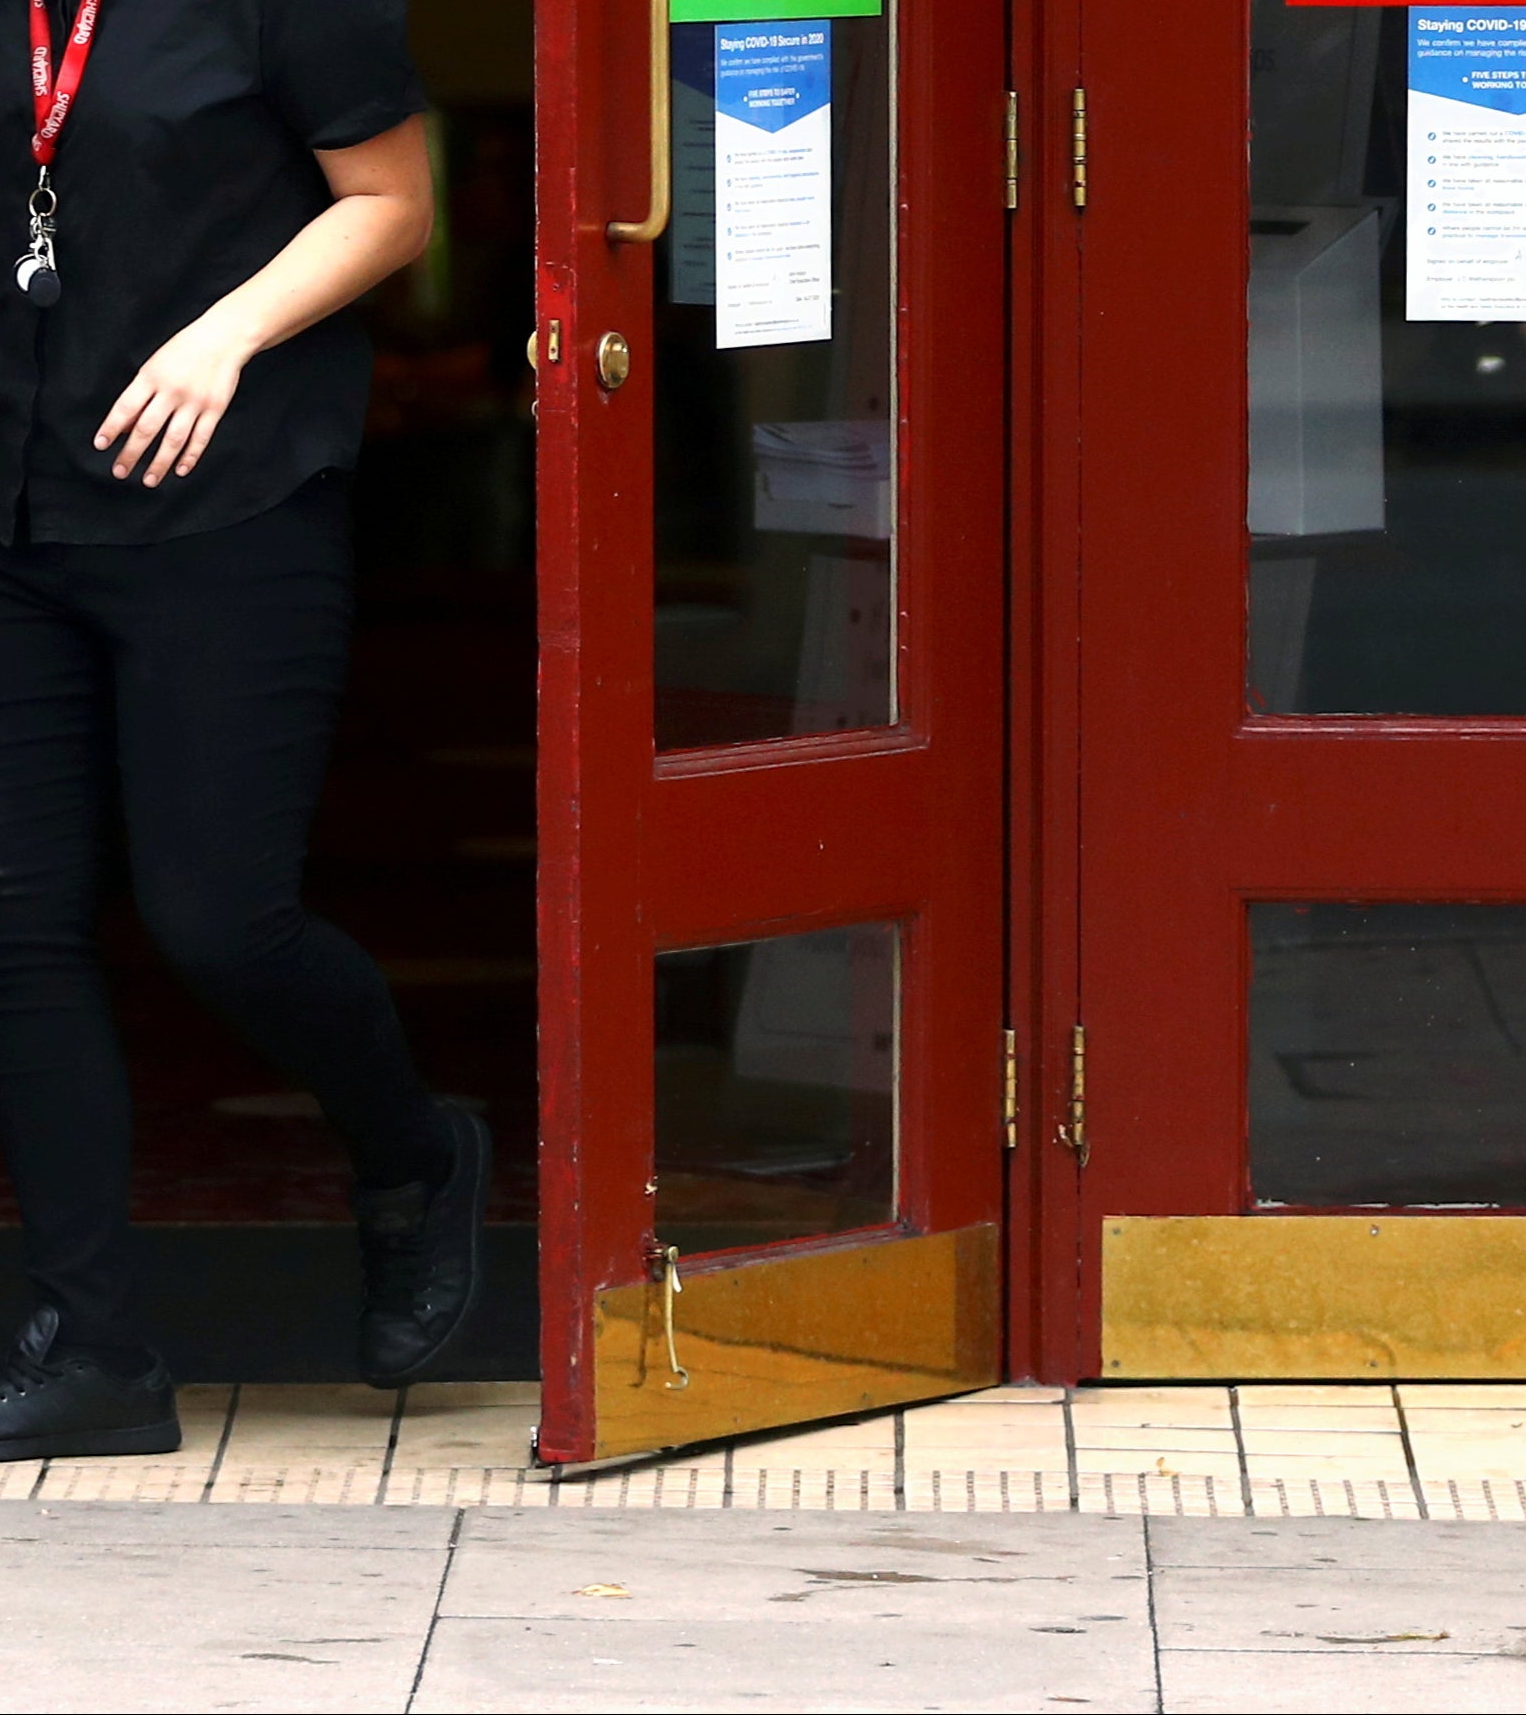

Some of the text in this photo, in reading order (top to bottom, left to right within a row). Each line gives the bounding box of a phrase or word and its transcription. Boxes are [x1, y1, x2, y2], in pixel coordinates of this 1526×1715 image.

[1418, 19, 1463, 33] Staying
[720, 38, 745, 52] Staying
[746, 36, 778, 48] COVID-19
[778, 35, 800, 46] Secure
[808, 33, 824, 44] 2020
